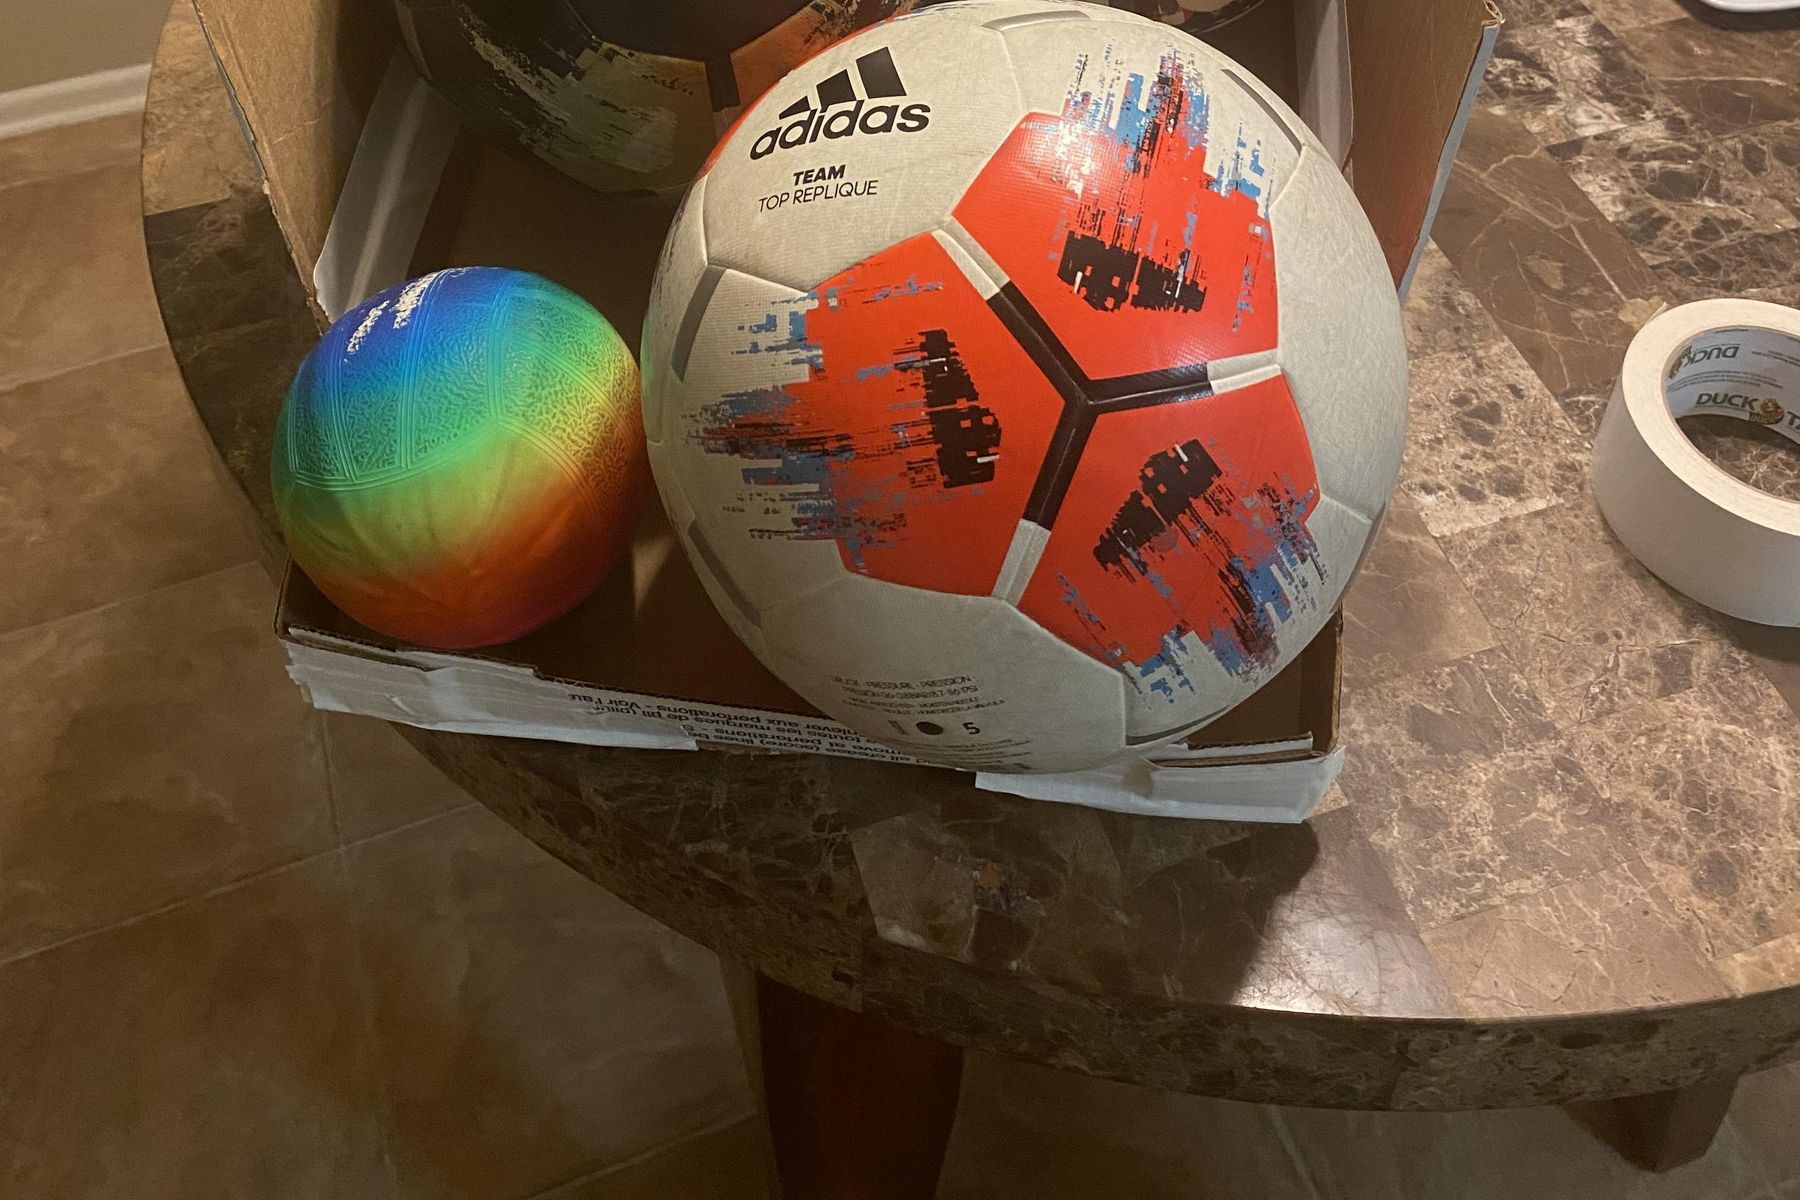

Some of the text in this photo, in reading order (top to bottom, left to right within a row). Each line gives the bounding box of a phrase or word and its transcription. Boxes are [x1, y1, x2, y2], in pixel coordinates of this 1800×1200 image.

[750, 99, 931, 160] adidas
[793, 164, 846, 186] TEAM
[758, 179, 879, 213] TOP REPLIQUE
[1683, 347, 1740, 367] DUCK
[1695, 392, 1759, 411] DUCK
[607, 699, 642, 710] Voir
[657, 705, 760, 723] perforations
[695, 718, 770, 731] marques
[767, 719, 799, 728] aux
[962, 722, 981, 735] 5
[687, 732, 710, 740] be
[714, 728, 822, 745] perforations
[775, 727, 801, 736] les
[807, 730, 860, 742] toutes
[713, 735, 754, 745] lines
[759, 740, 820, 752] (score)
[826, 748, 886, 759] crease
